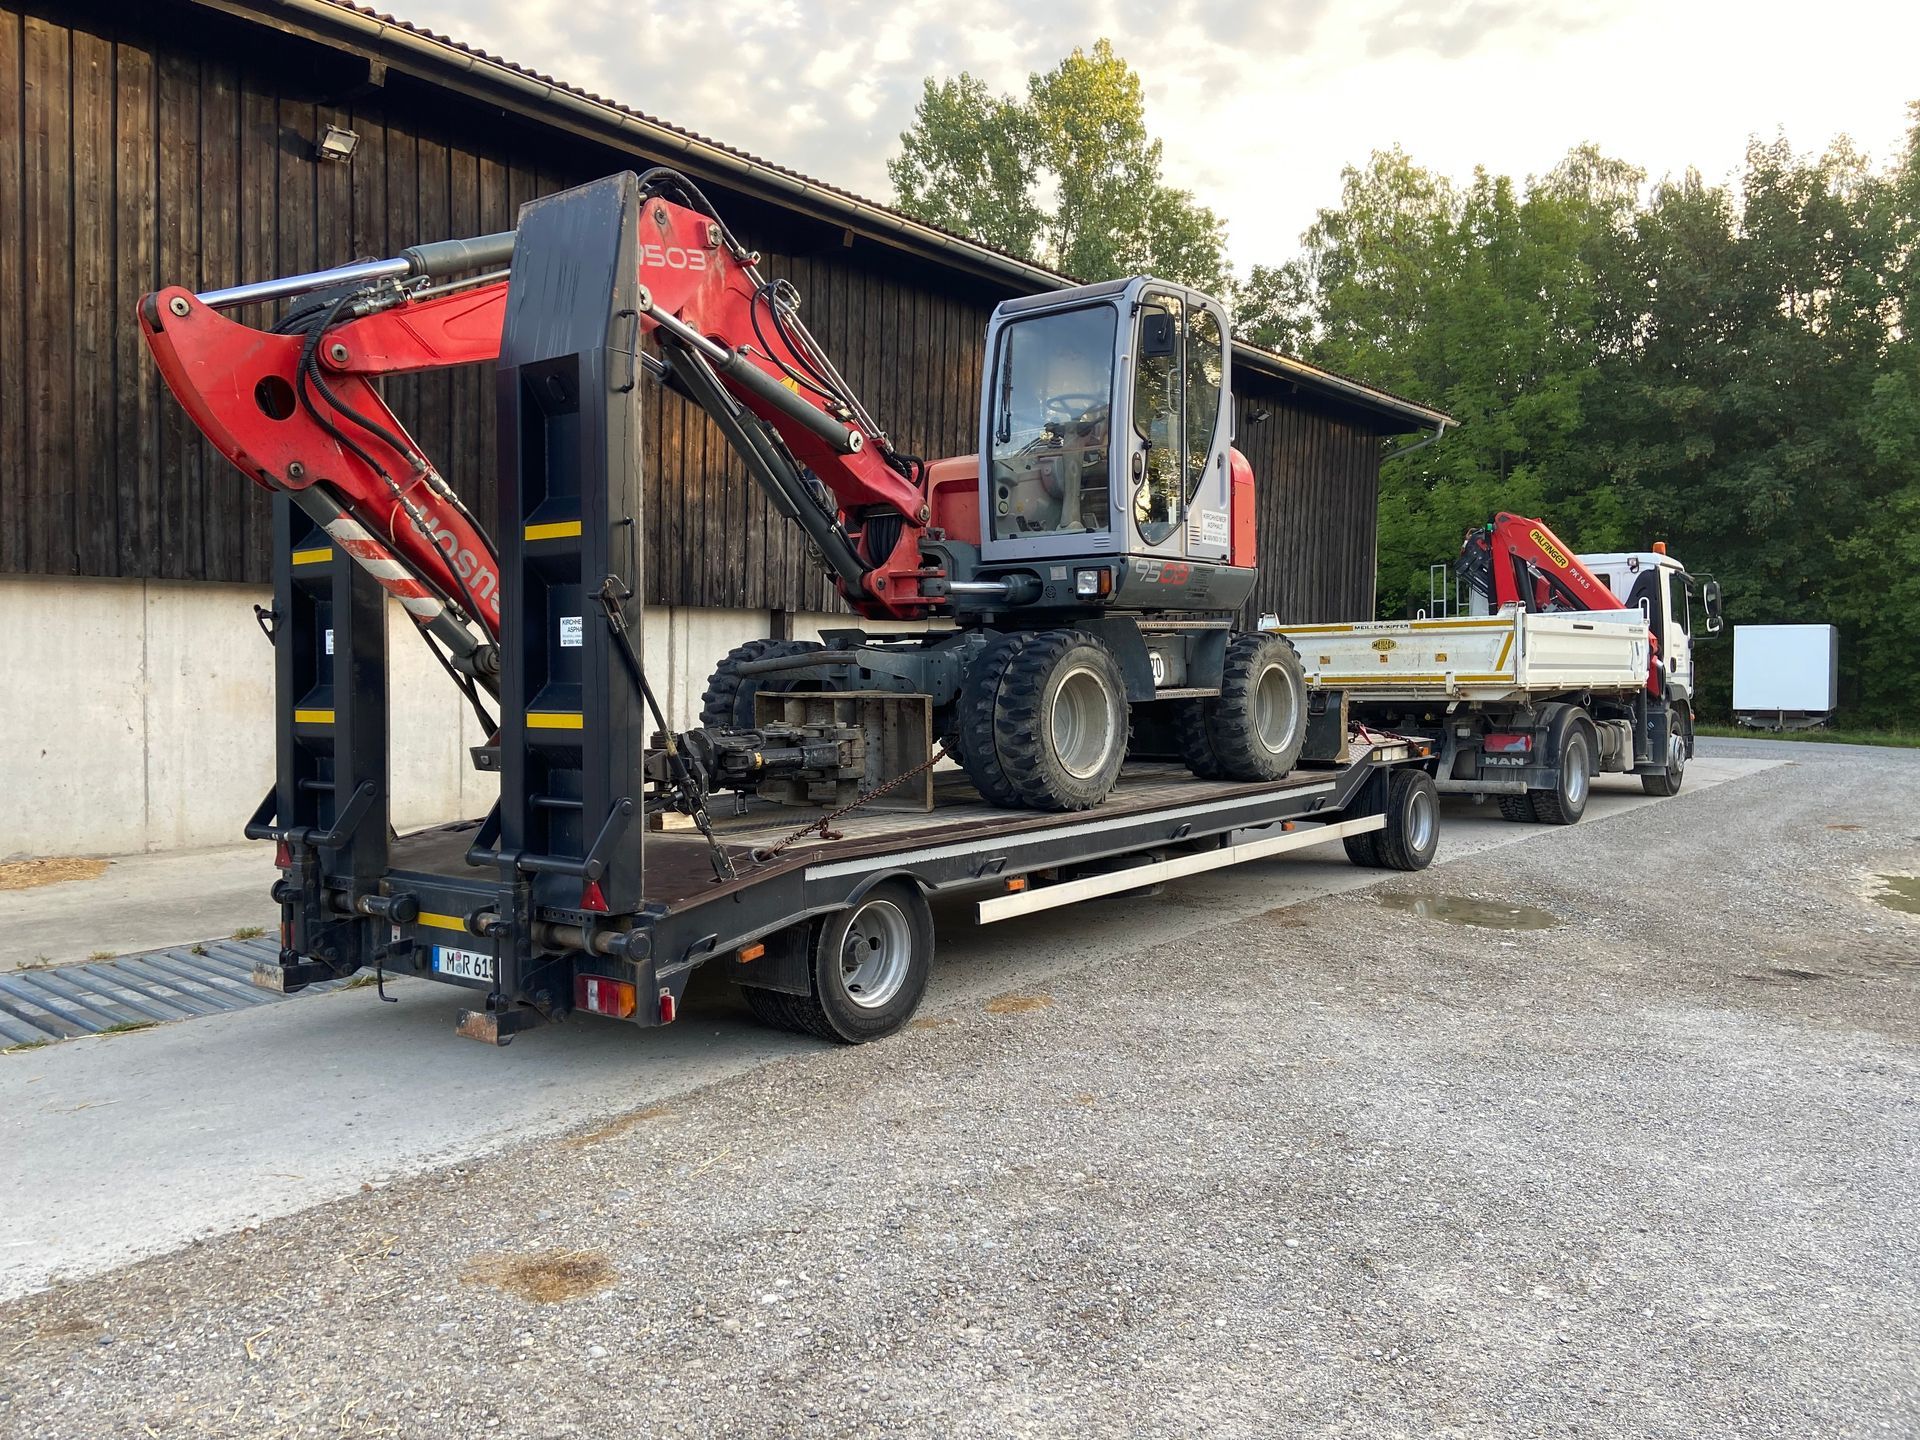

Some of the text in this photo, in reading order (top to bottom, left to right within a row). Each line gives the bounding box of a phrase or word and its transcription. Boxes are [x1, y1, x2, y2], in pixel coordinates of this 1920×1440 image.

[638, 244, 706, 271] 503
[1531, 531, 1567, 567] PALFINGER
[1136, 560, 1190, 585] 9503
[1570, 568, 1580, 578] PK
[1485, 756, 1525, 766] MAN
[446, 951, 455, 972] M
[462, 954, 471, 975] R
